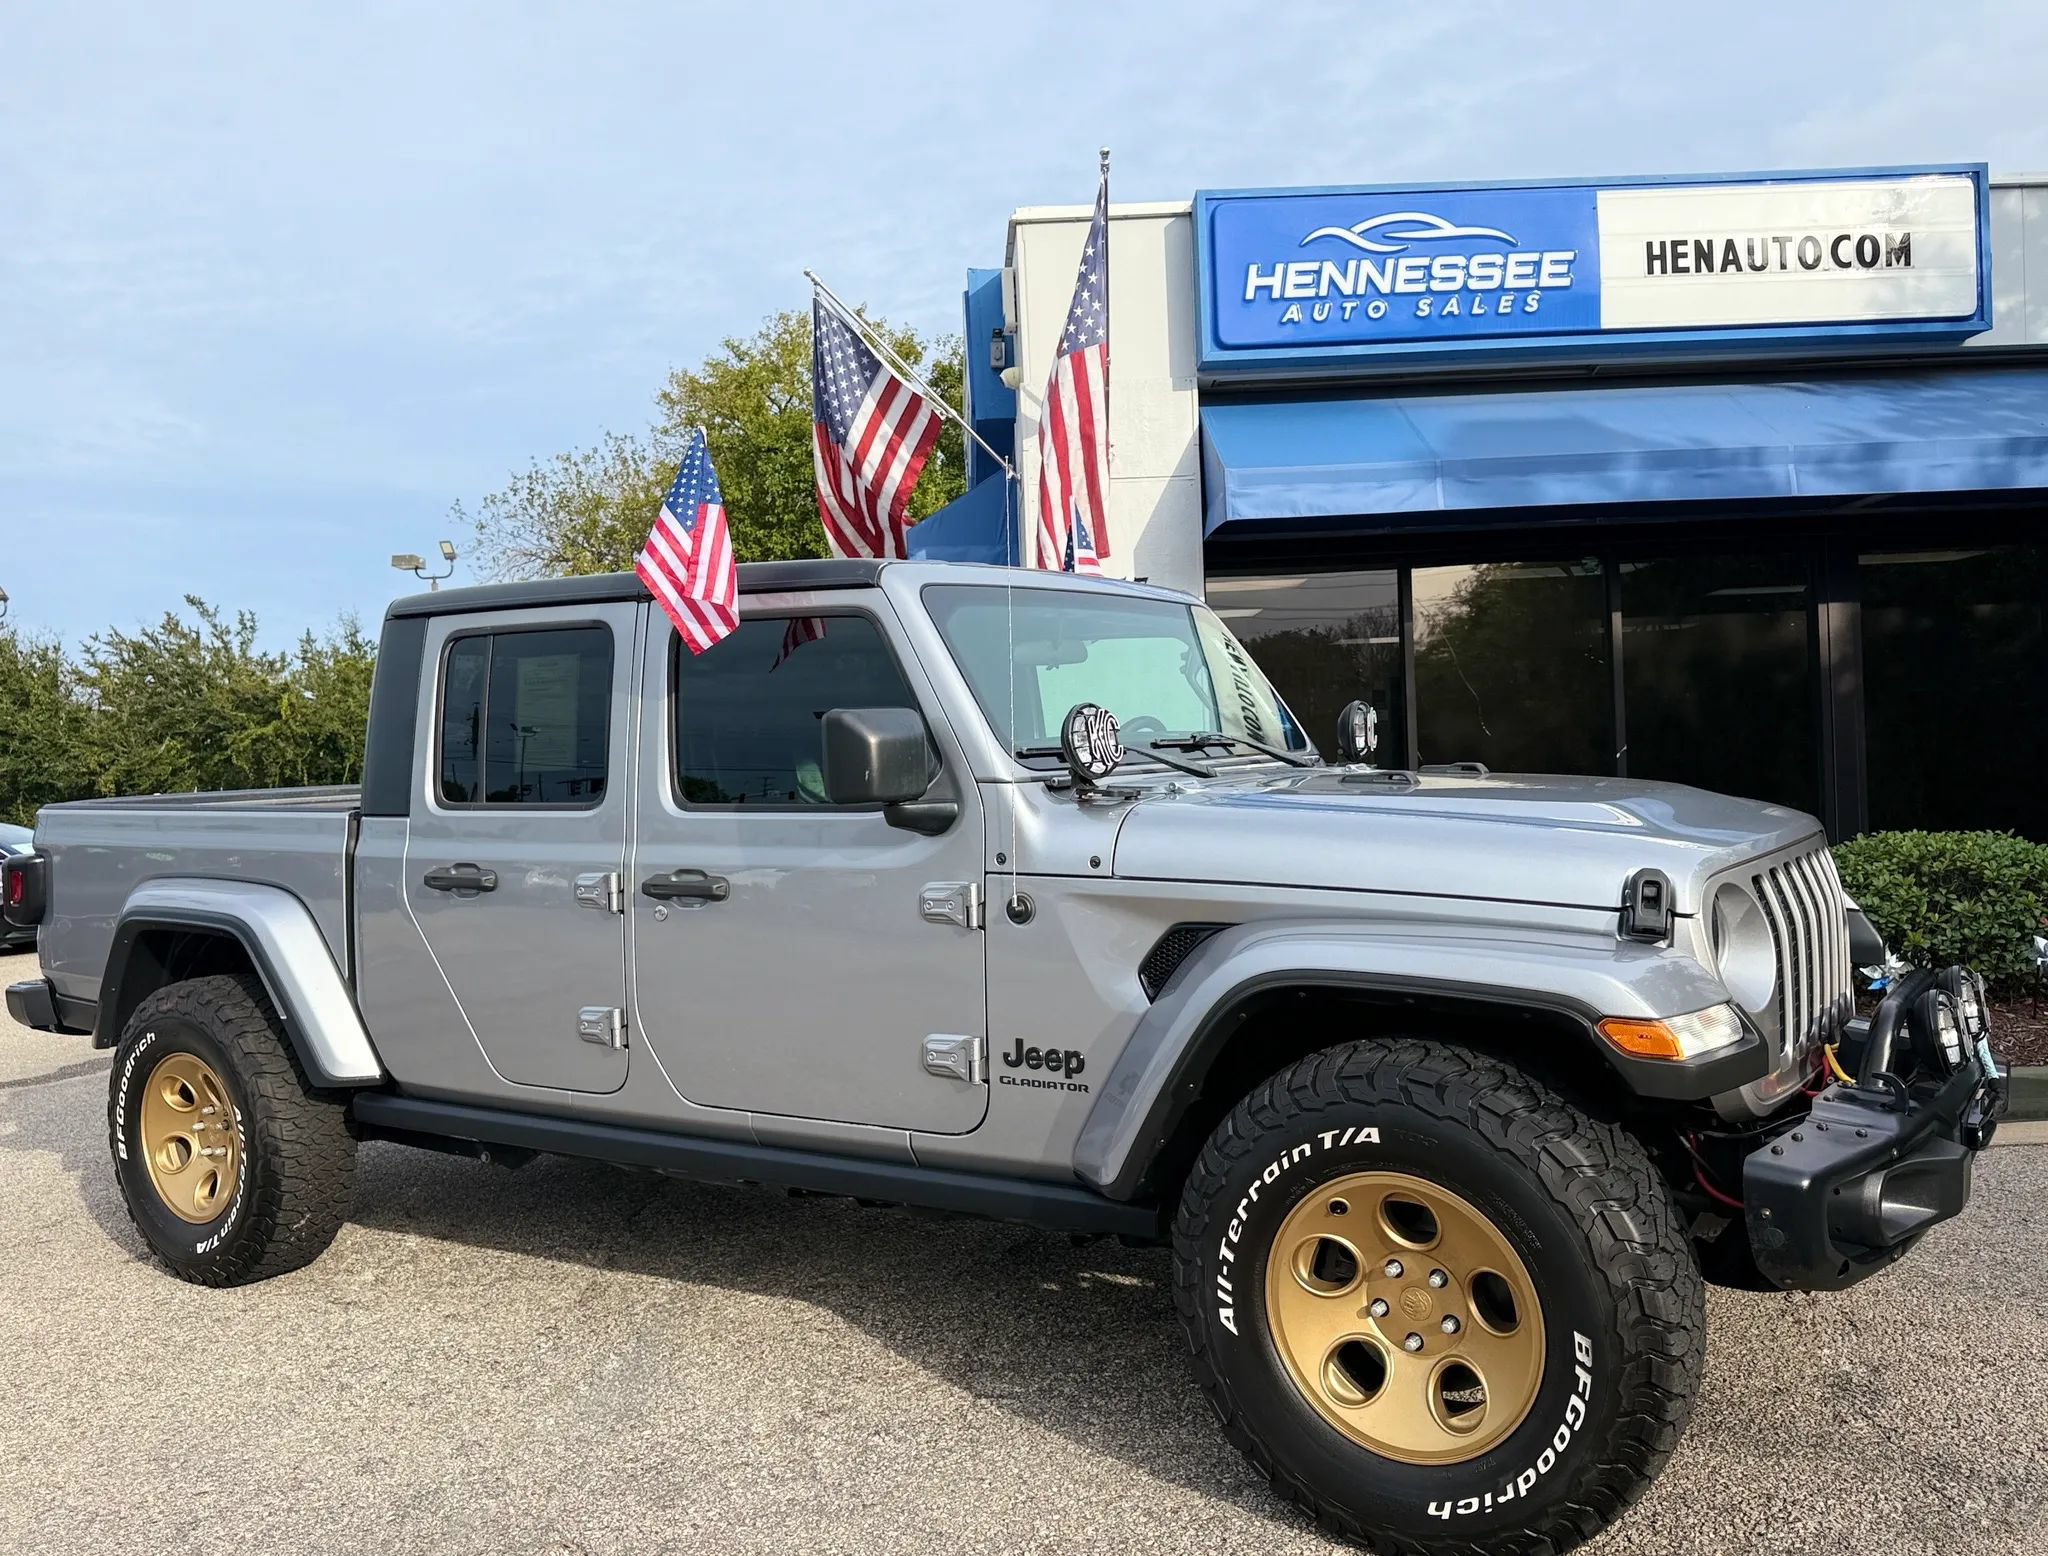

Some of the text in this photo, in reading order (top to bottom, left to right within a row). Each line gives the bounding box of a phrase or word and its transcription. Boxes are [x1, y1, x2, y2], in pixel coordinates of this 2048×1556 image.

[1244, 250, 1576, 300] HENNESSEE
[1280, 291, 1544, 324] AUTO SALES
[116, 1031, 156, 1160] BFGoodrich
[999, 1075, 1090, 1093] GLADIATOR
[1002, 1037, 1085, 1079] Jeep
[222, 1104, 248, 1238] All-Terrain
[1217, 1126, 1381, 1336] All-Terrain T/A
[1426, 1330, 1593, 1521] BFGoodrich
